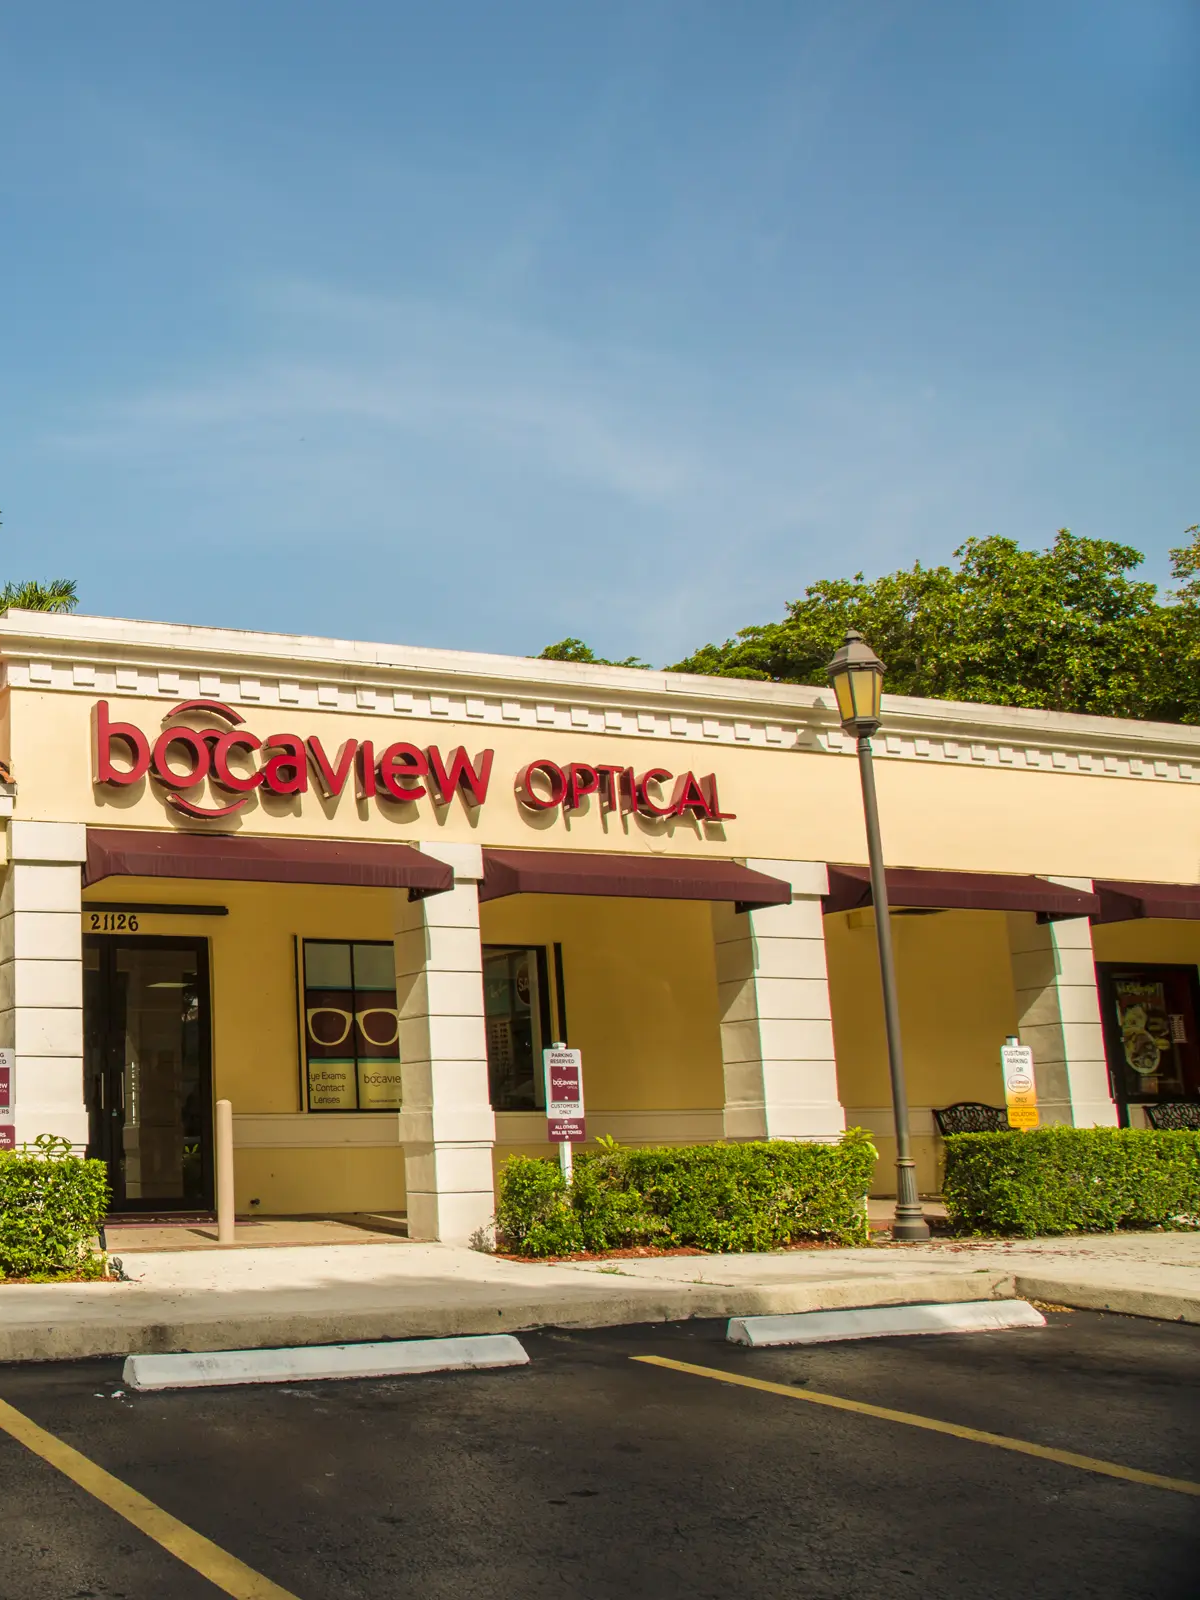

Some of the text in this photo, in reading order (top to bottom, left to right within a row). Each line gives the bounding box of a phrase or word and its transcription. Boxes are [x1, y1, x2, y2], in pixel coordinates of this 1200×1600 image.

[92, 699, 737, 823] bocaview OPTICAL
[91, 914, 138, 931] 21126
